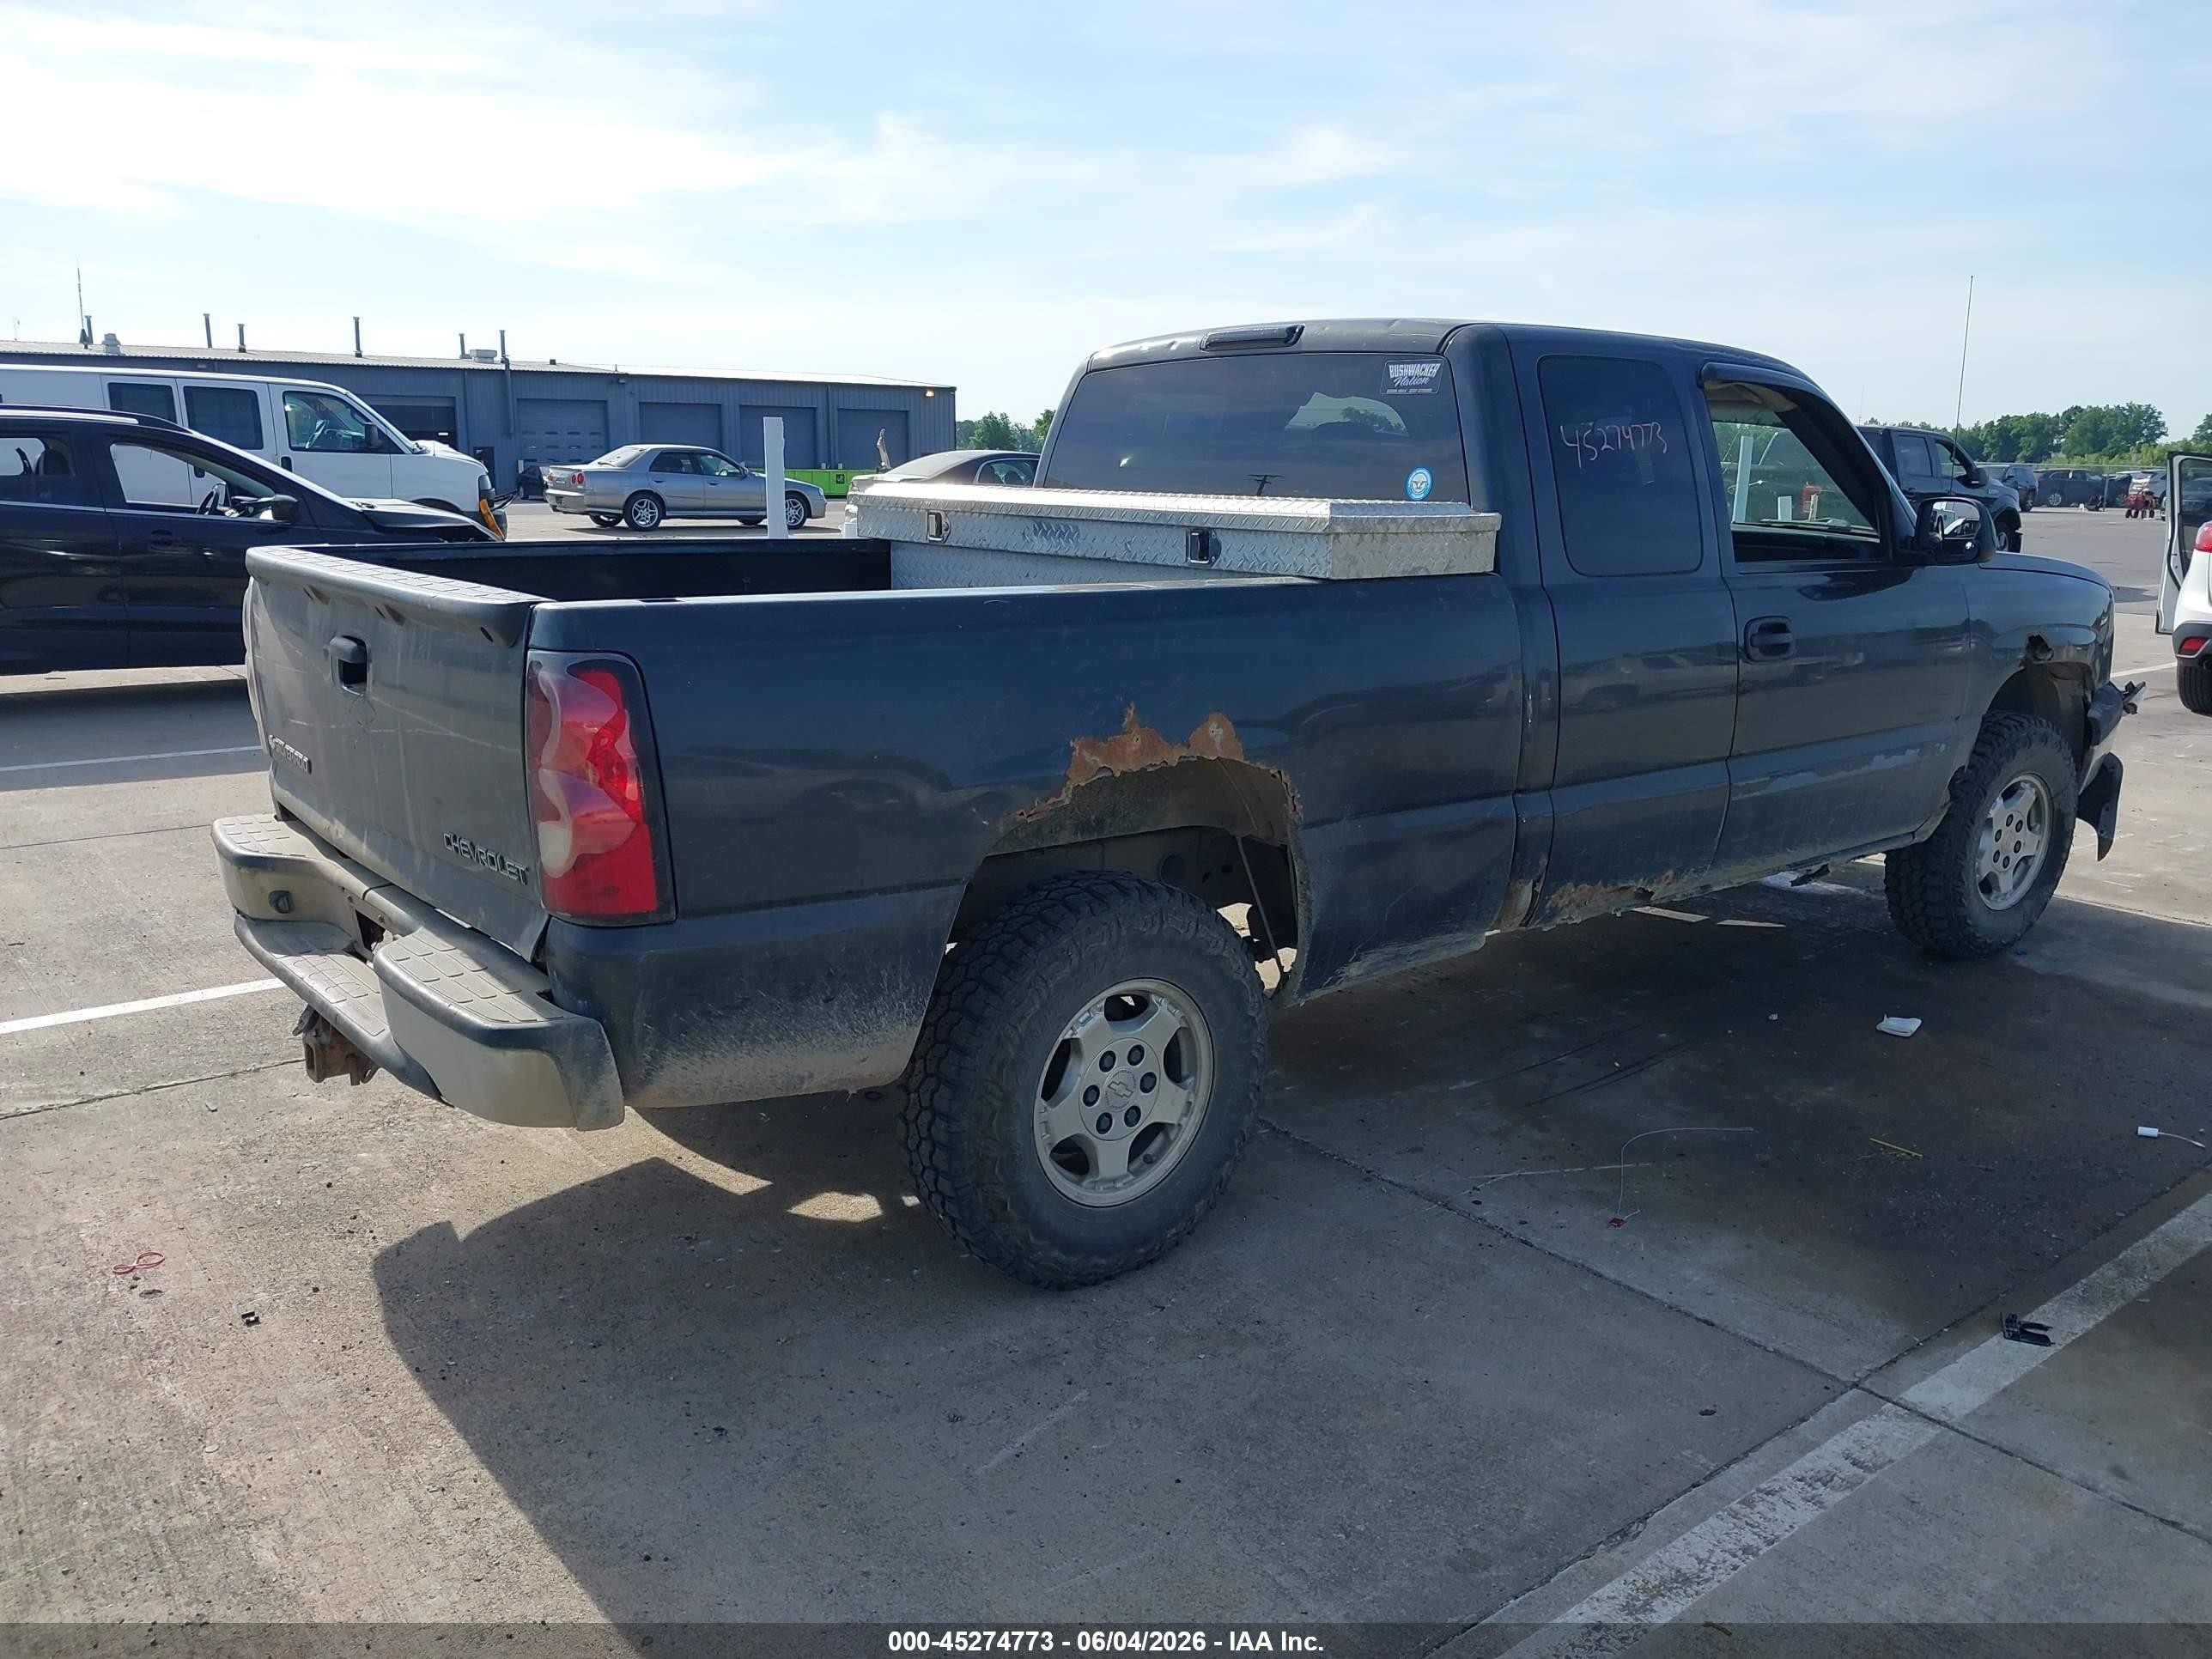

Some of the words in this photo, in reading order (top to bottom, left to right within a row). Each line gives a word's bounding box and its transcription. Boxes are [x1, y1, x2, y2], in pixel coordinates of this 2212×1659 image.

[1389, 363, 1442, 379] BUSHWACKER
[1393, 376, 1431, 388] Nation
[1559, 422, 1668, 469] 45274773
[443, 832, 529, 886] CHEVROLET
